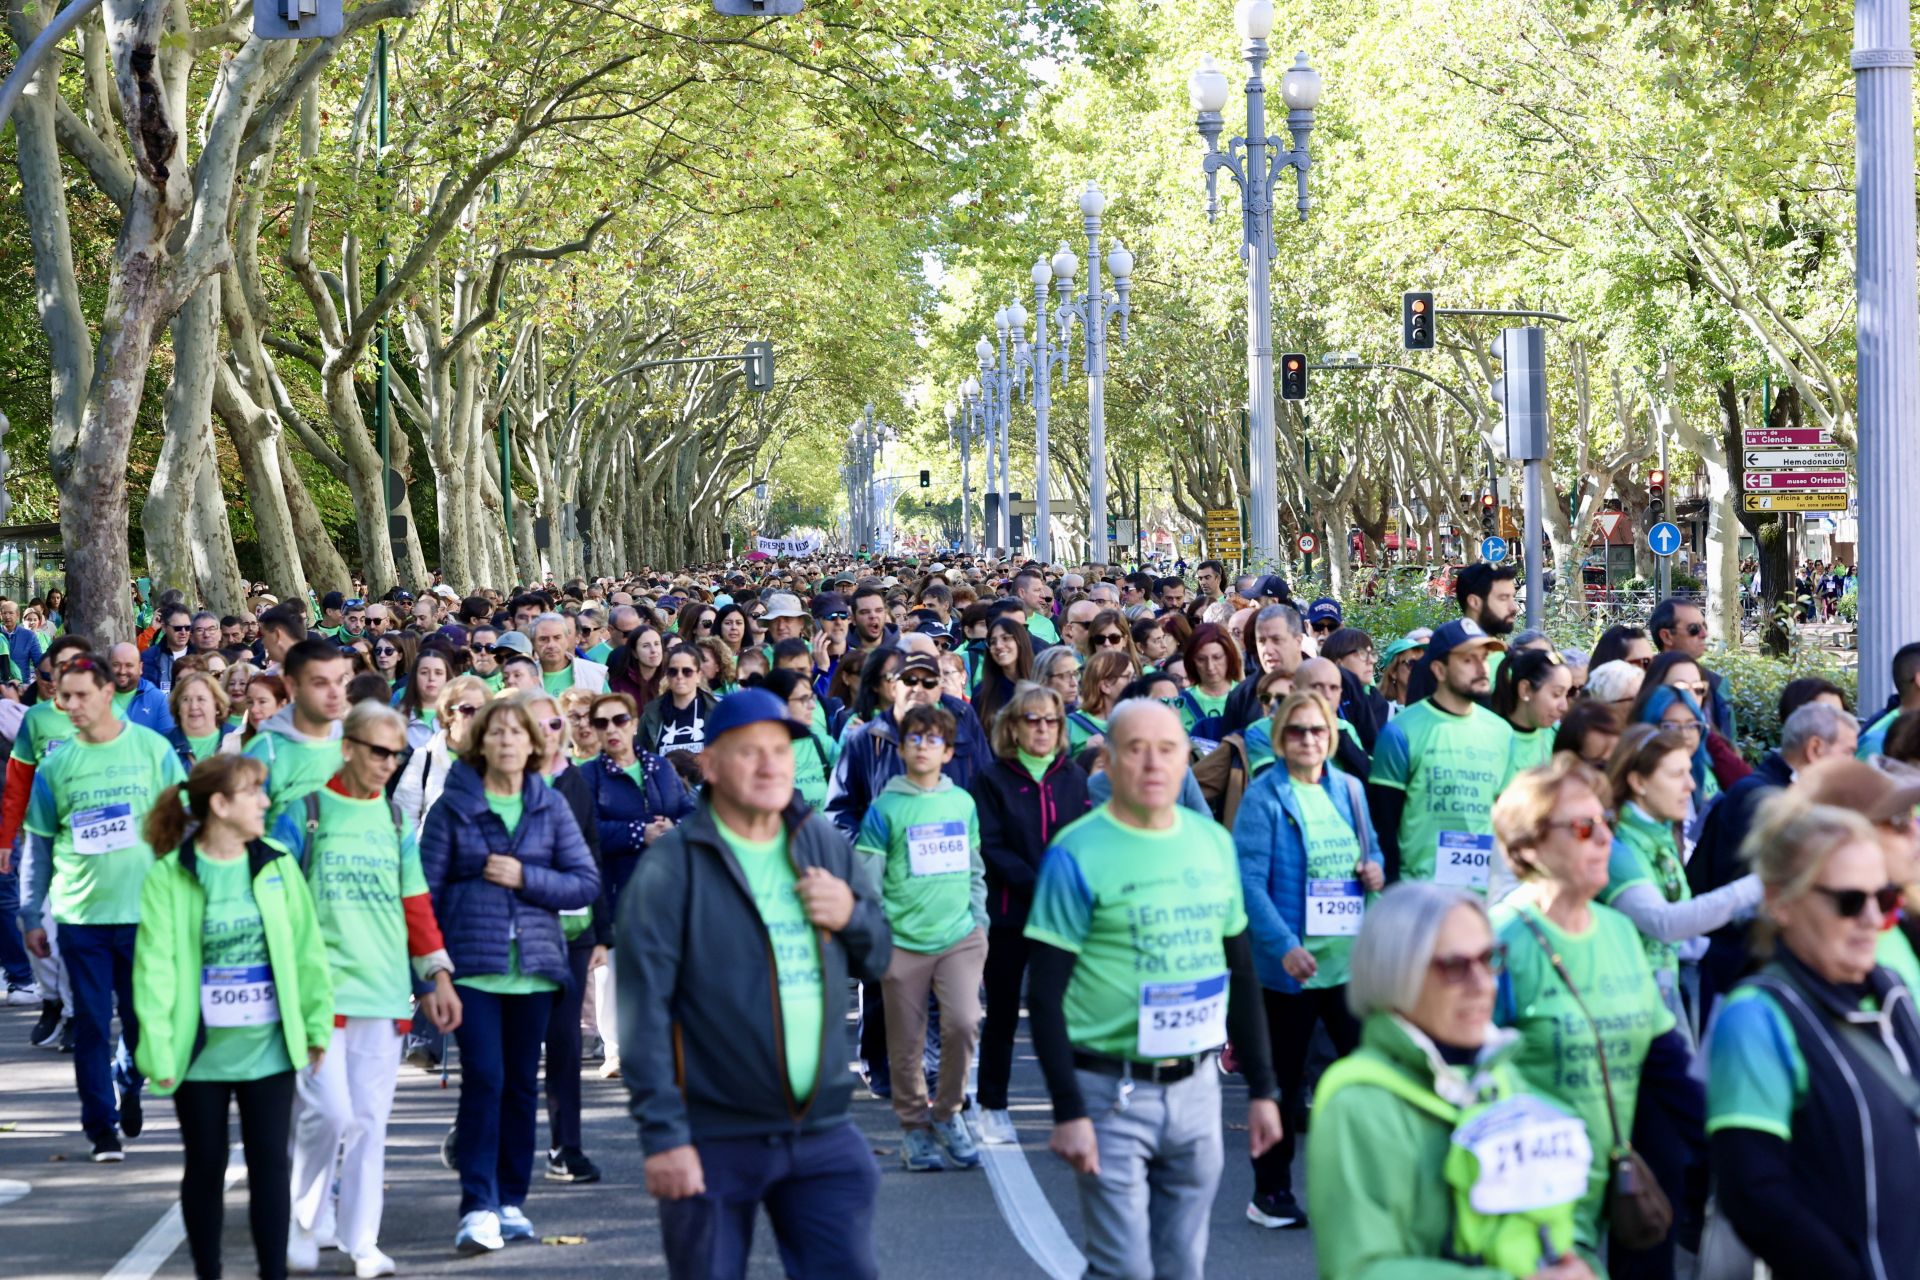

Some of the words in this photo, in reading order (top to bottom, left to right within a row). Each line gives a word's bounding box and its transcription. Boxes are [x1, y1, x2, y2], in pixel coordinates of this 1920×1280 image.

[1761, 436, 1793, 444] Ciencia
[1783, 457, 1845, 466] Hemodonación
[1810, 476, 1845, 484] Oriental
[1301, 539, 1312, 547] 50
[1433, 766, 1453, 780] En
[71, 790, 89, 801] En
[1433, 783, 1479, 798] contra
[1433, 797, 1447, 812] el
[80, 819, 127, 839] 46342
[918, 840, 964, 856] 39668
[324, 851, 346, 865] En
[325, 870, 379, 884] contra
[326, 887, 341, 900] el
[1139, 904, 1168, 927] En
[1143, 926, 1213, 950] contra
[1145, 953, 1169, 975] el
[211, 985, 273, 1005] 50635
